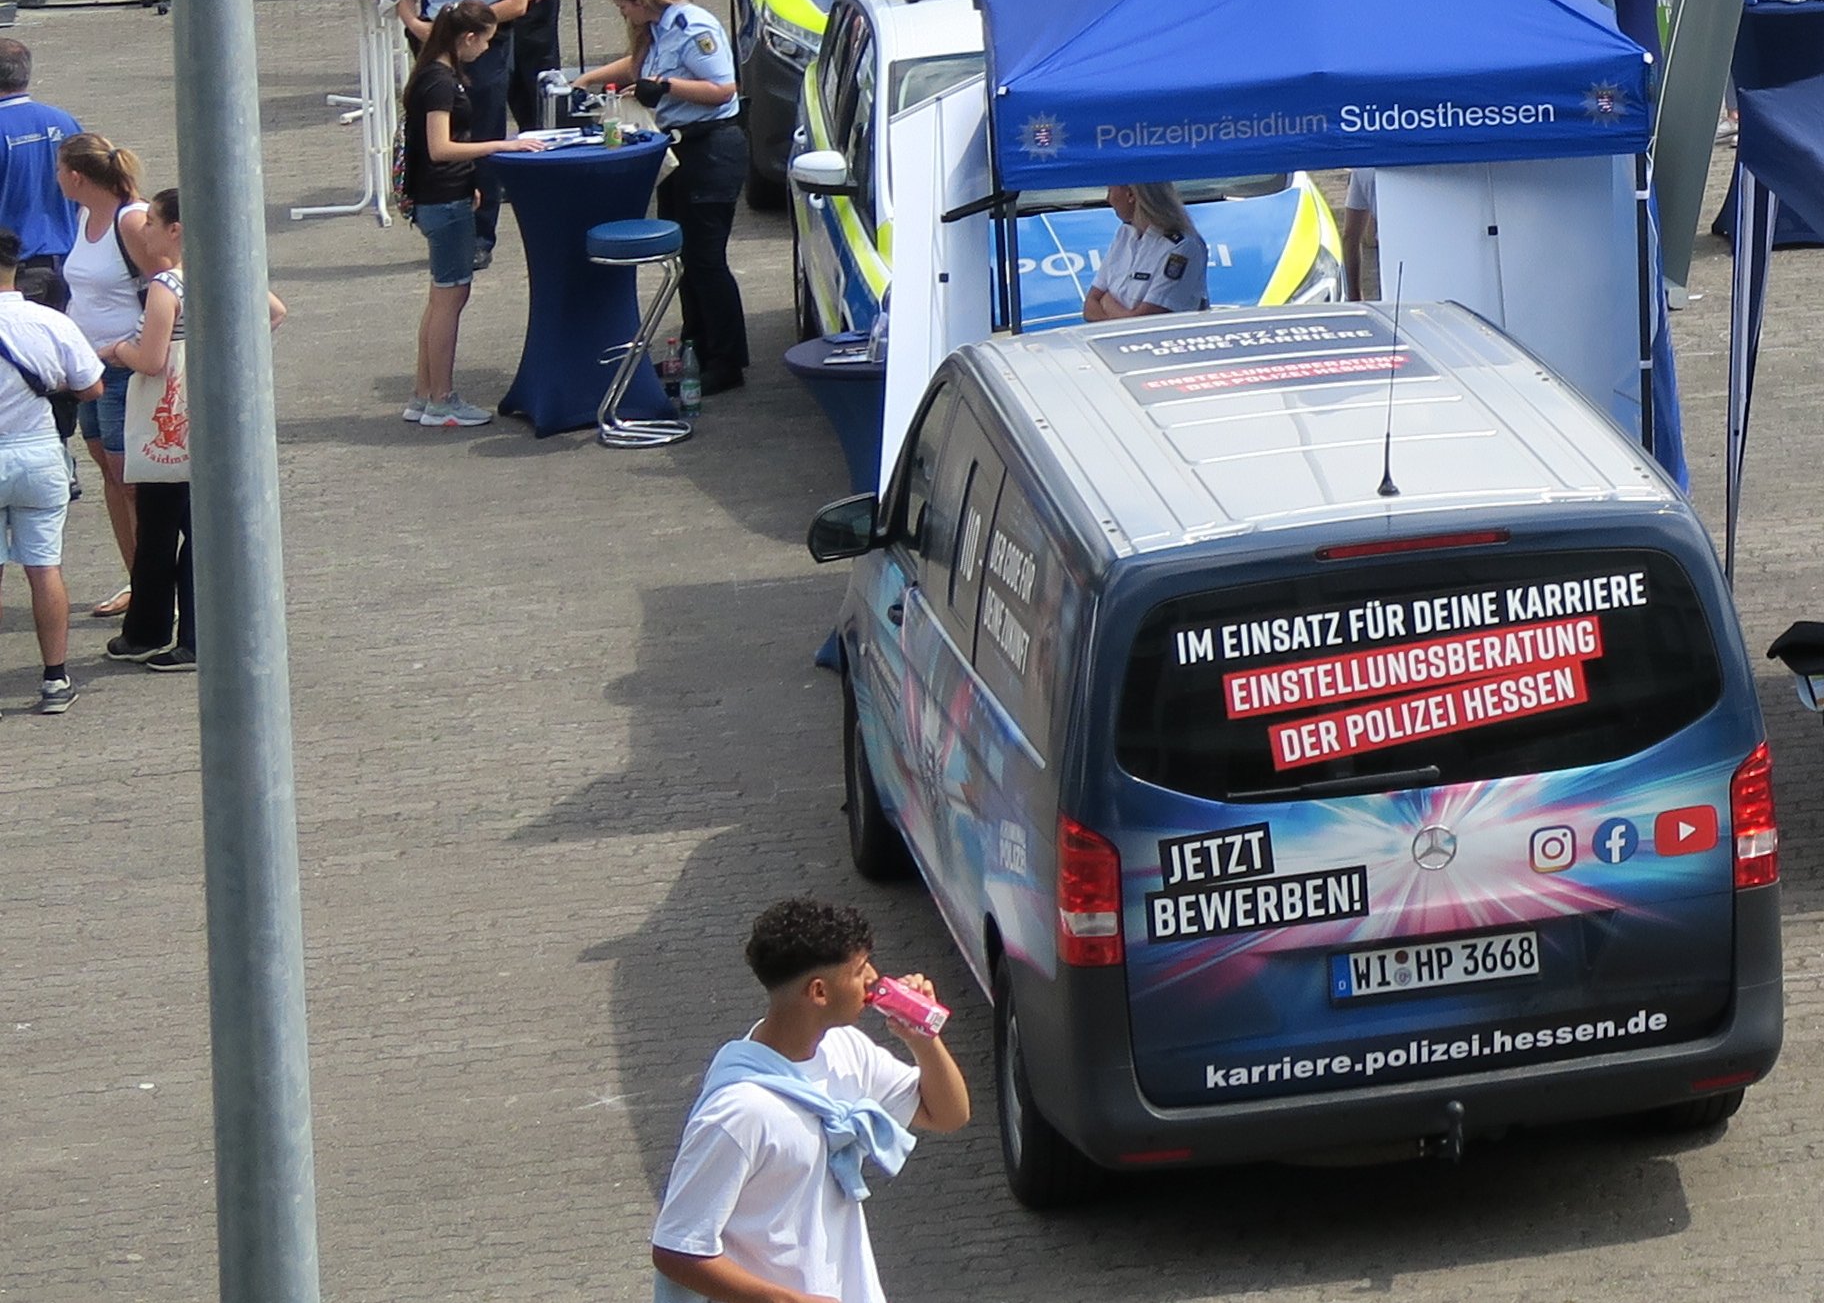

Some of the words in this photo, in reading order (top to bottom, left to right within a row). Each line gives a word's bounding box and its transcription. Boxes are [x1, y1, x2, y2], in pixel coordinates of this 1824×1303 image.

[1096, 110, 1328, 151] Polizeipräsidium
[1340, 100, 1556, 134] Südosthessen
[1119, 340, 1154, 354] IM
[1159, 329, 1273, 350] EINSATZ
[1273, 324, 1329, 338] FÜR
[1151, 339, 1234, 357] DEINE
[1241, 329, 1373, 346] KARRIERE
[1231, 370, 1312, 386] POLIZEI
[142, 442, 190, 466] Waidma
[1176, 630, 1215, 666] IM
[1222, 611, 1344, 659] EINSATZ
[1348, 600, 1405, 641] FÜR
[1412, 591, 1498, 633] DEINE
[1505, 571, 1648, 622] KARRIERE
[1230, 620, 1597, 713] EINSTELLUNGSBERATUNG
[1280, 723, 1341, 764] DER
[1345, 694, 1456, 750] POLIZEI
[1463, 666, 1577, 721] HESSEN
[1167, 829, 1266, 885] JETZT
[1153, 873, 1363, 939] BEWERBEN!
[1352, 954, 1391, 992] WI
[1415, 947, 1454, 982] HP
[1463, 936, 1537, 978] 3668
[1205, 1009, 1669, 1090] karriere.polizei.hessen.de
